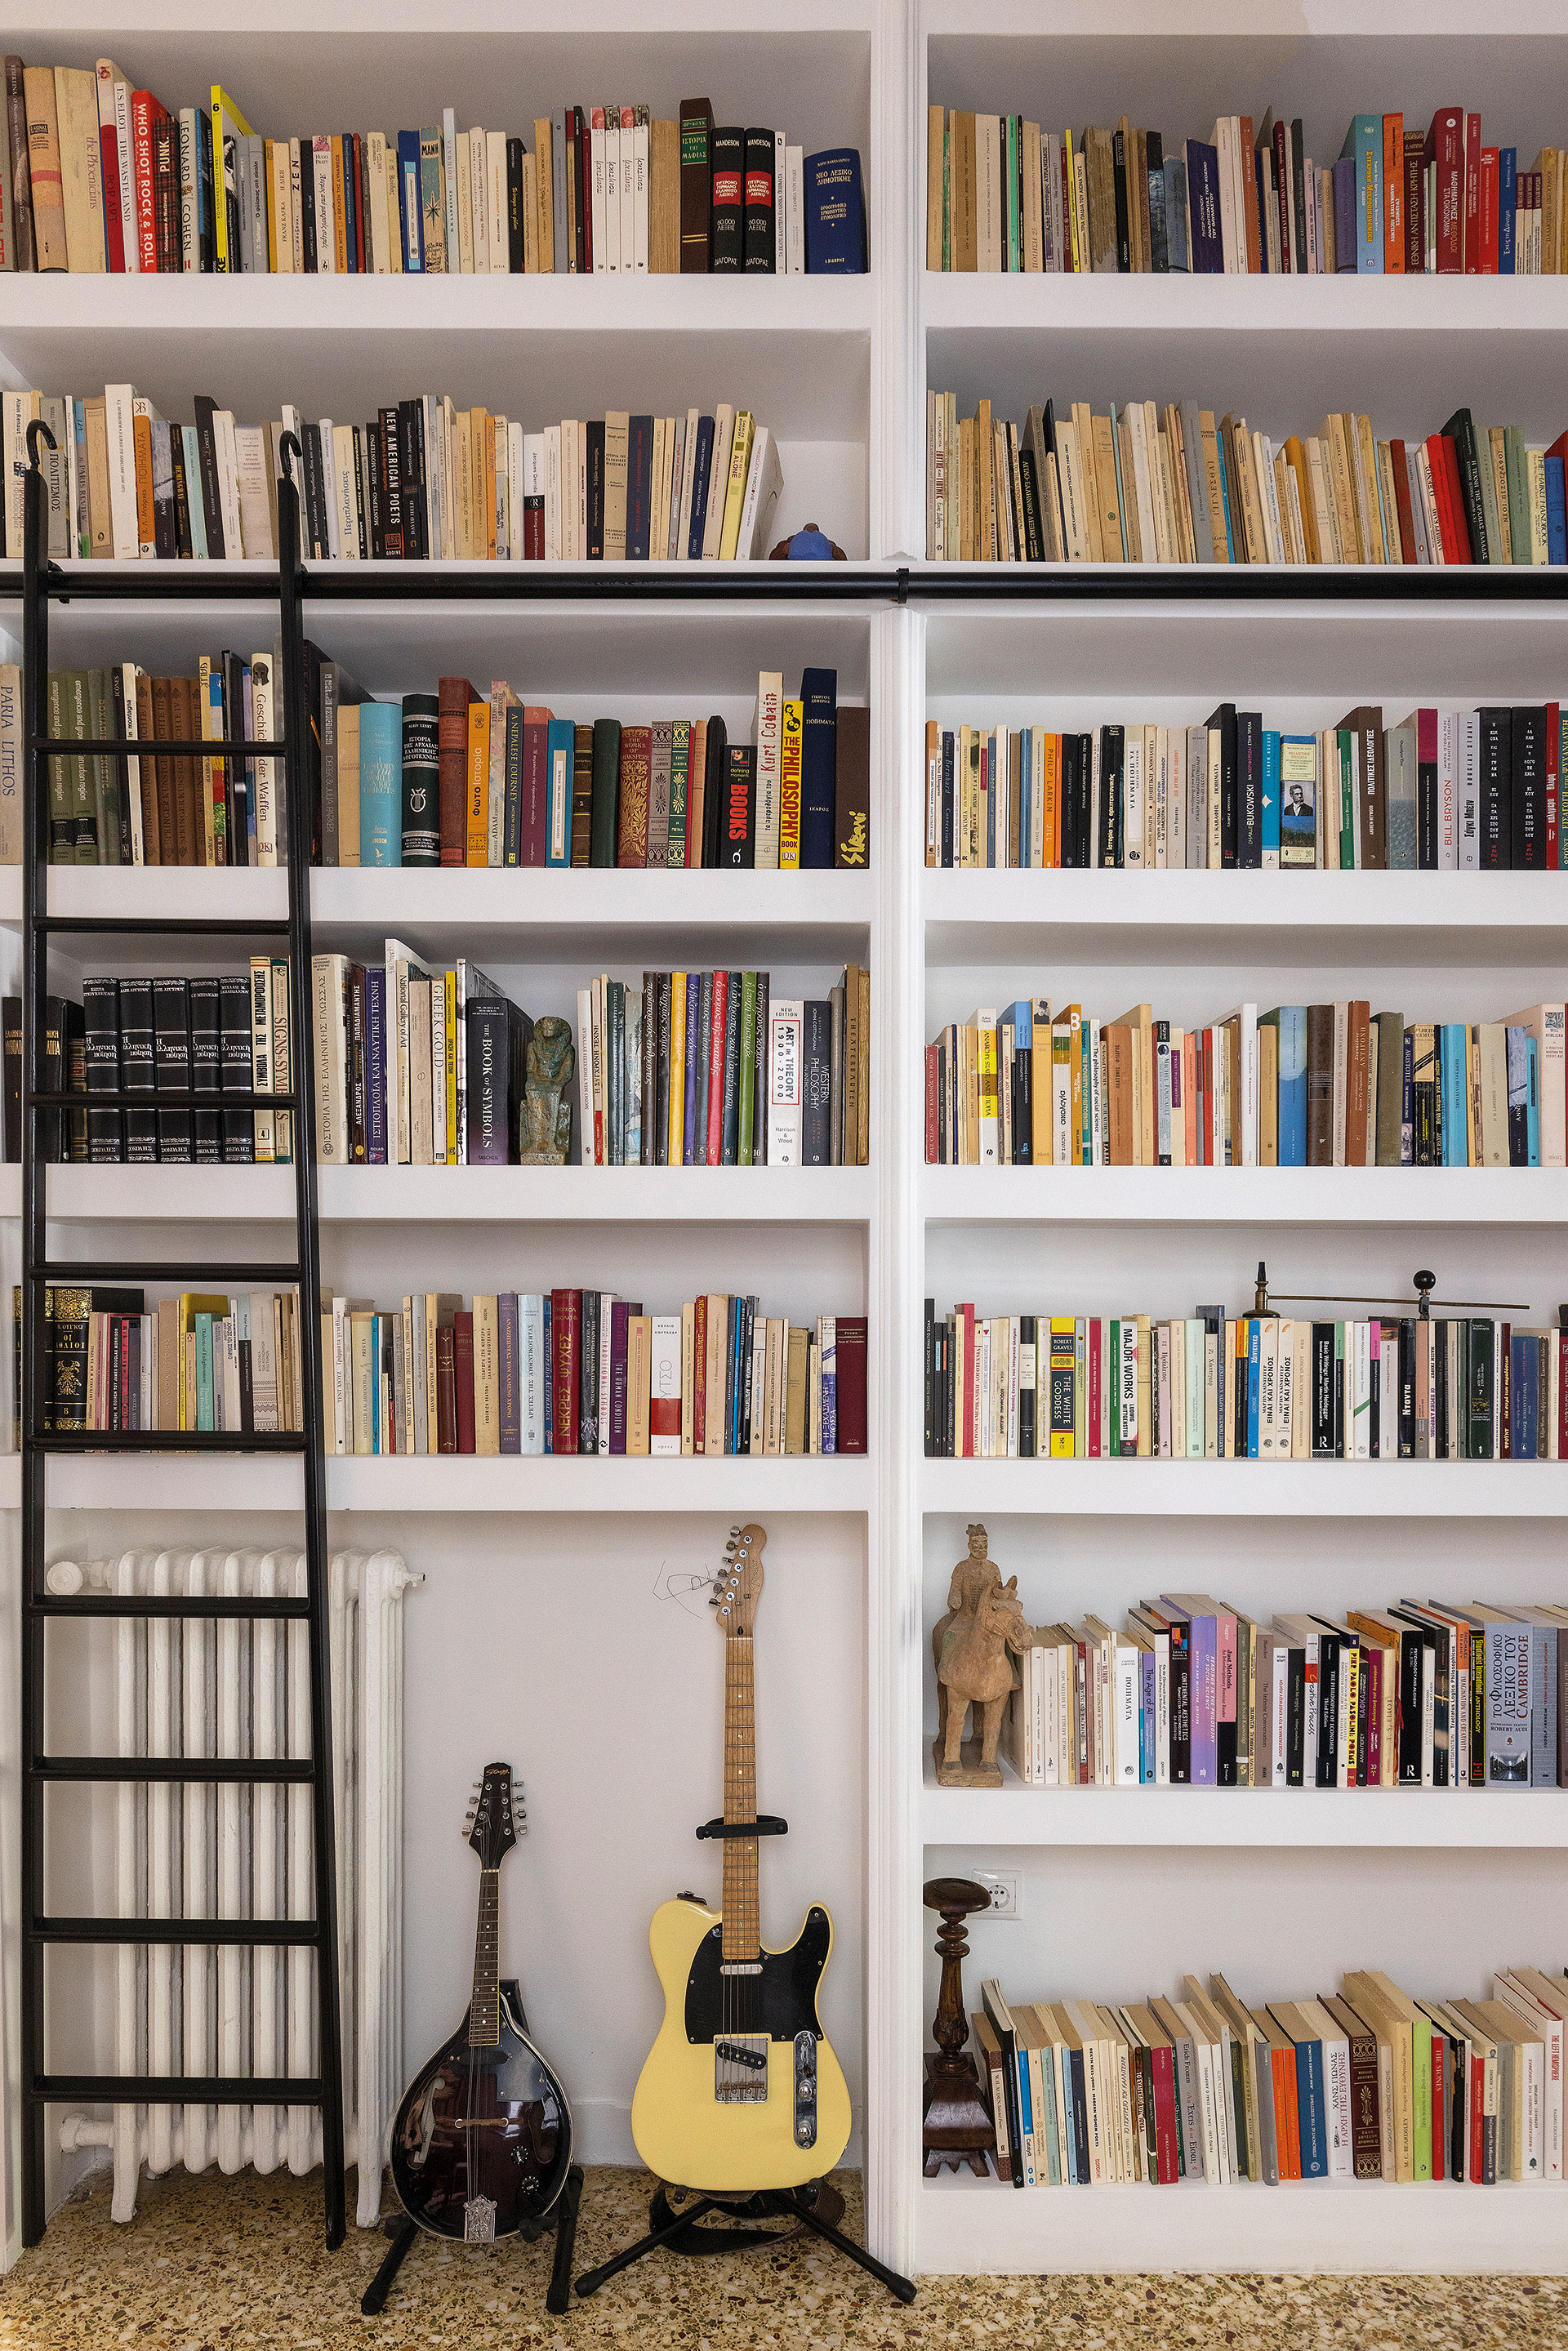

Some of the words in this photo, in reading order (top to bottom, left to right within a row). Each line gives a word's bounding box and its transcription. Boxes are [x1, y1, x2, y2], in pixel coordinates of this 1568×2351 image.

[136, 104, 147, 136] WHO
[212, 103, 220, 112] 6
[138, 140, 149, 175] SHOT
[159, 137, 170, 172] PUNK.
[180, 121, 190, 182] LEONARD
[140, 180, 151, 216] ROCK
[182, 205, 192, 251] COHEN
[143, 232, 154, 267] ROLL
[385, 412, 396, 430] NEW
[387, 436, 399, 488] AMERICAN
[390, 492, 401, 524] POETS
[784, 737, 800, 746] THE
[729, 784, 748, 839] BOOKS
[782, 747, 800, 839] PHILOSOPHY
[1246, 784, 1254, 826] BUKOWSKI
[1444, 826, 1452, 846] BILL
[434, 985, 444, 1026] GREEK
[256, 1033, 267, 1046] ΤΗΣ
[434, 1031, 444, 1068] GOLD
[786, 1026, 795, 1046] ART
[483, 1039, 492, 1076] BOOK
[785, 1058, 794, 1099] THEORY
[482, 1087, 492, 1148] SYMBOLS
[559, 1333, 572, 1378] ΨΥΧΕΣ
[1122, 1328, 1133, 1361] MAJOR
[1122, 1363, 1134, 1400] WORKS
[559, 1386, 571, 1437] ΝΕΚΡΕΣ
[1504, 1635, 1516, 1659] ΤΟΥ
[1145, 1682, 1153, 1697] Age
[1503, 1666, 1516, 1718] ΛΕΞΙΚΟ
[1517, 1635, 1528, 1718] CAMBRIDGE
